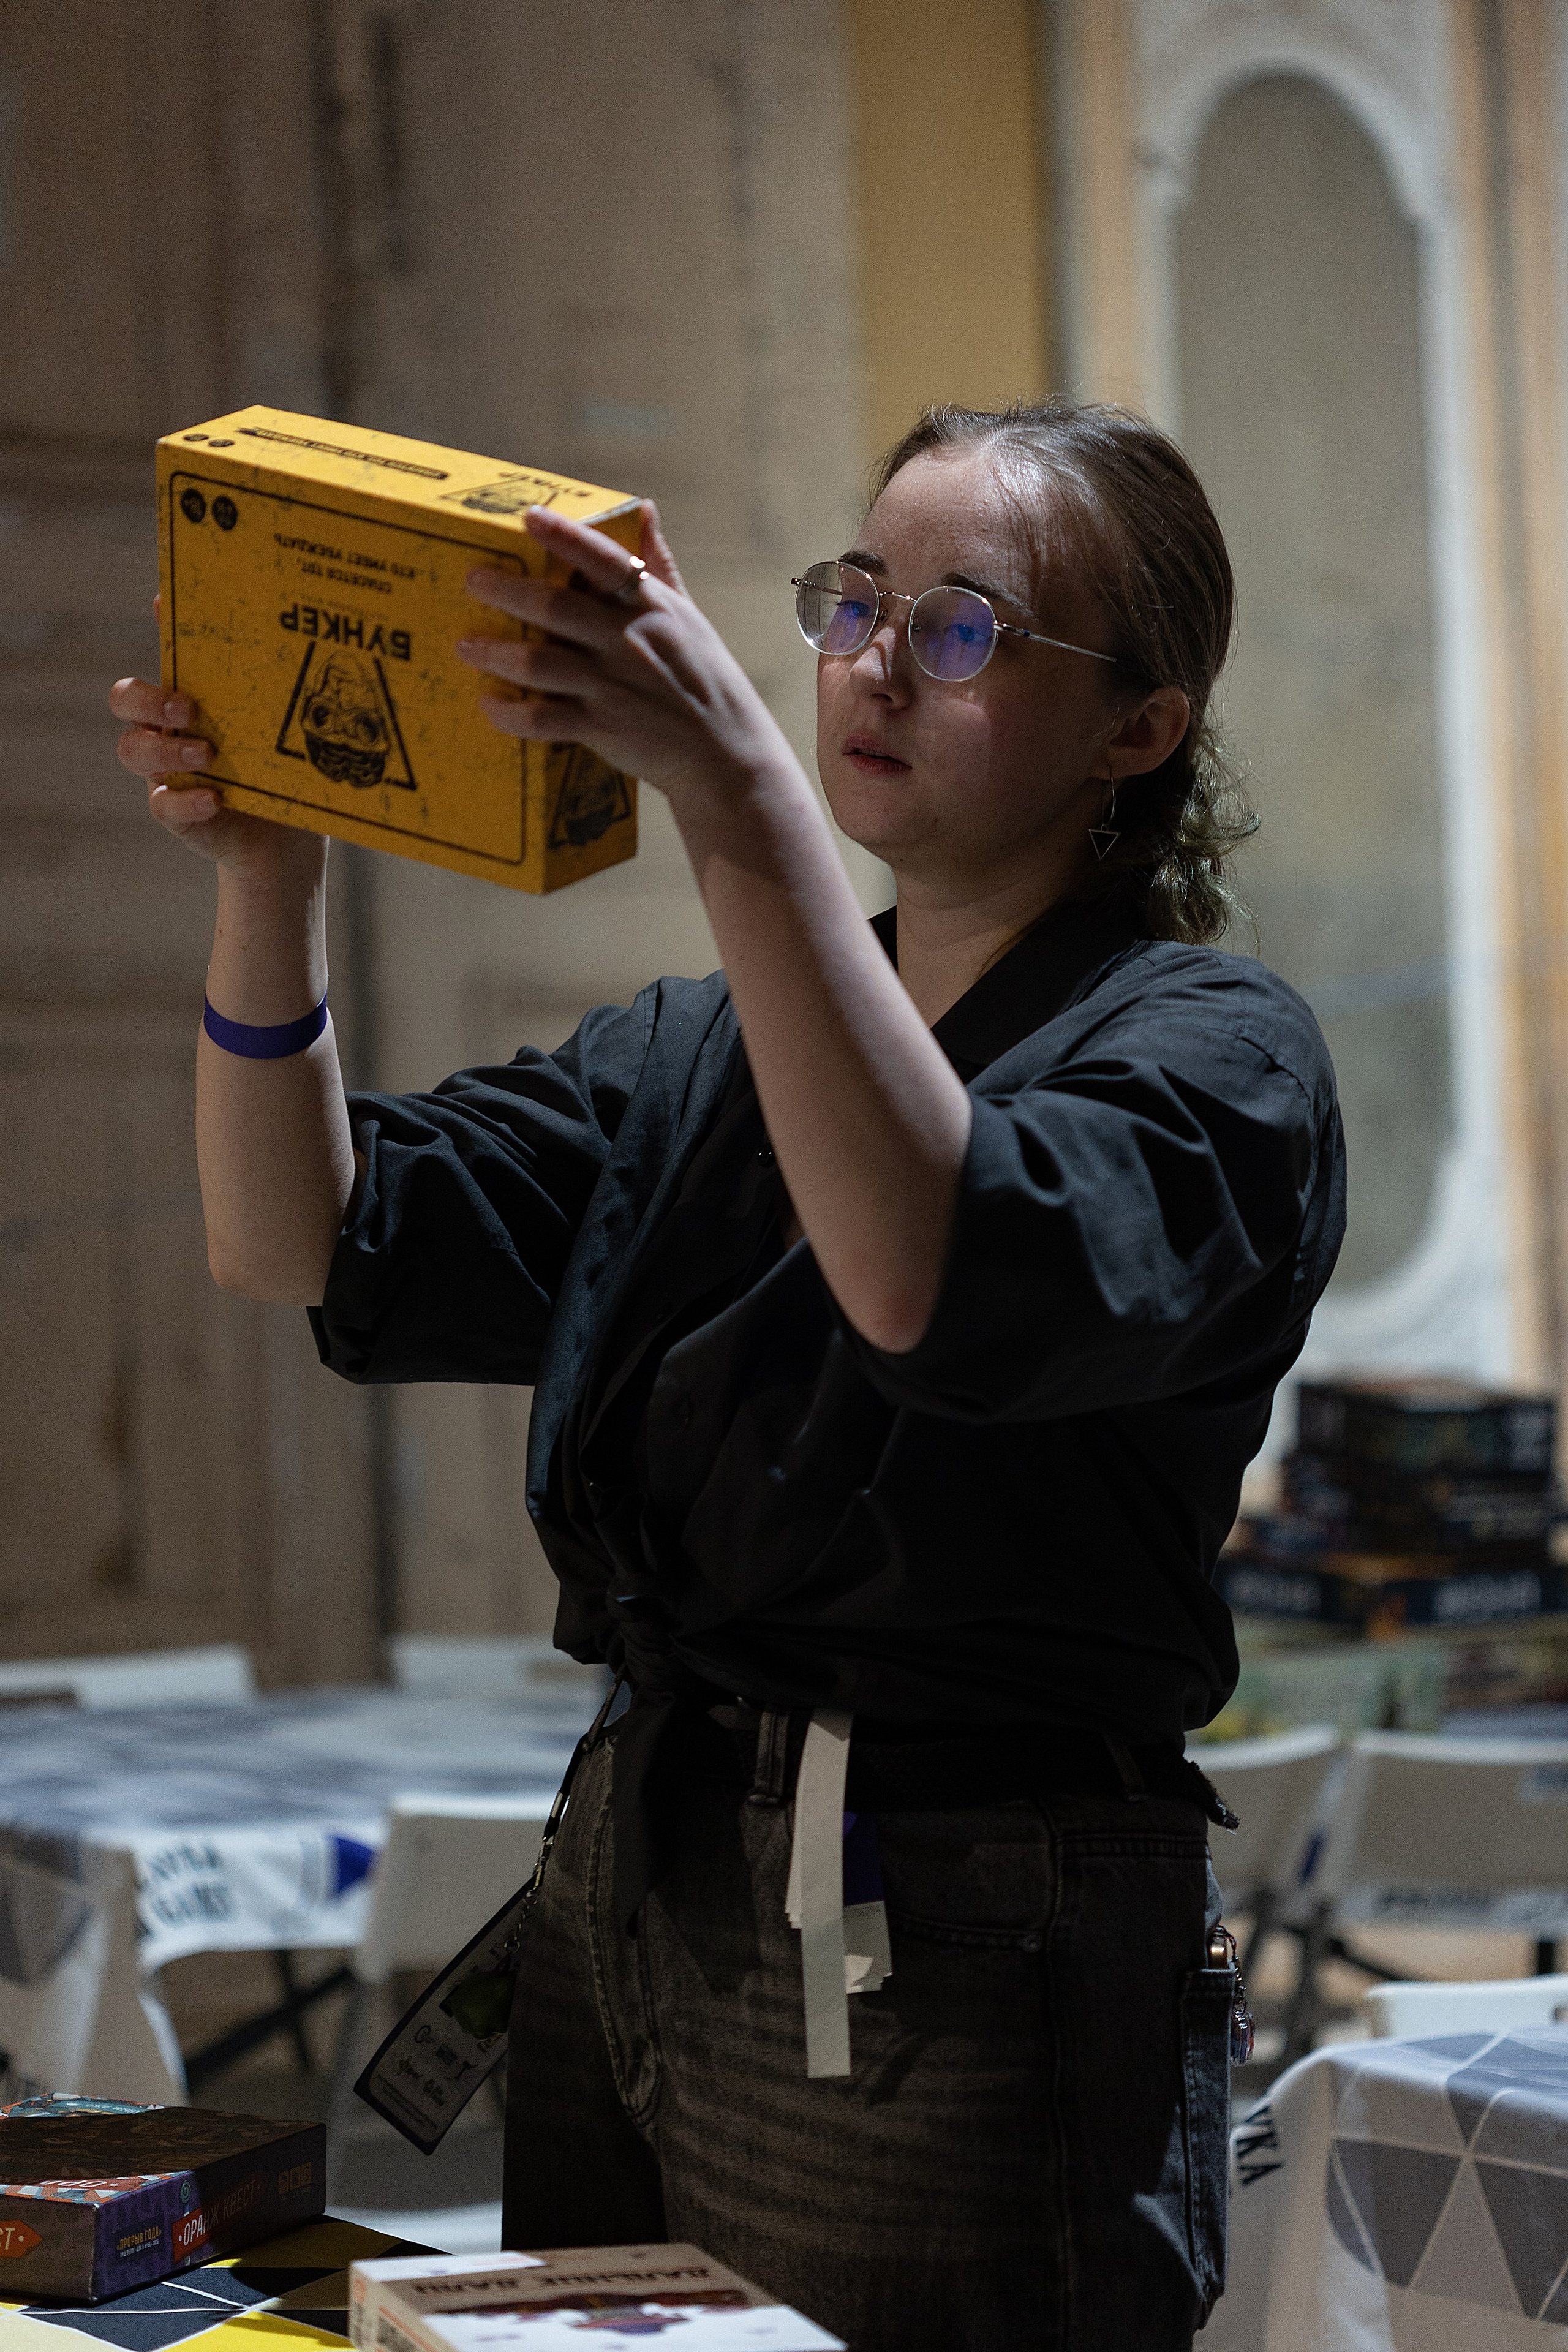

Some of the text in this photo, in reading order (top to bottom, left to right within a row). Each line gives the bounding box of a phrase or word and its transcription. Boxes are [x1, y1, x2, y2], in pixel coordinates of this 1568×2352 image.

[278, 603, 411, 662] БУНКЕР
[183, 2179, 257, 2247] ОРАНЖ КВЕСТ
